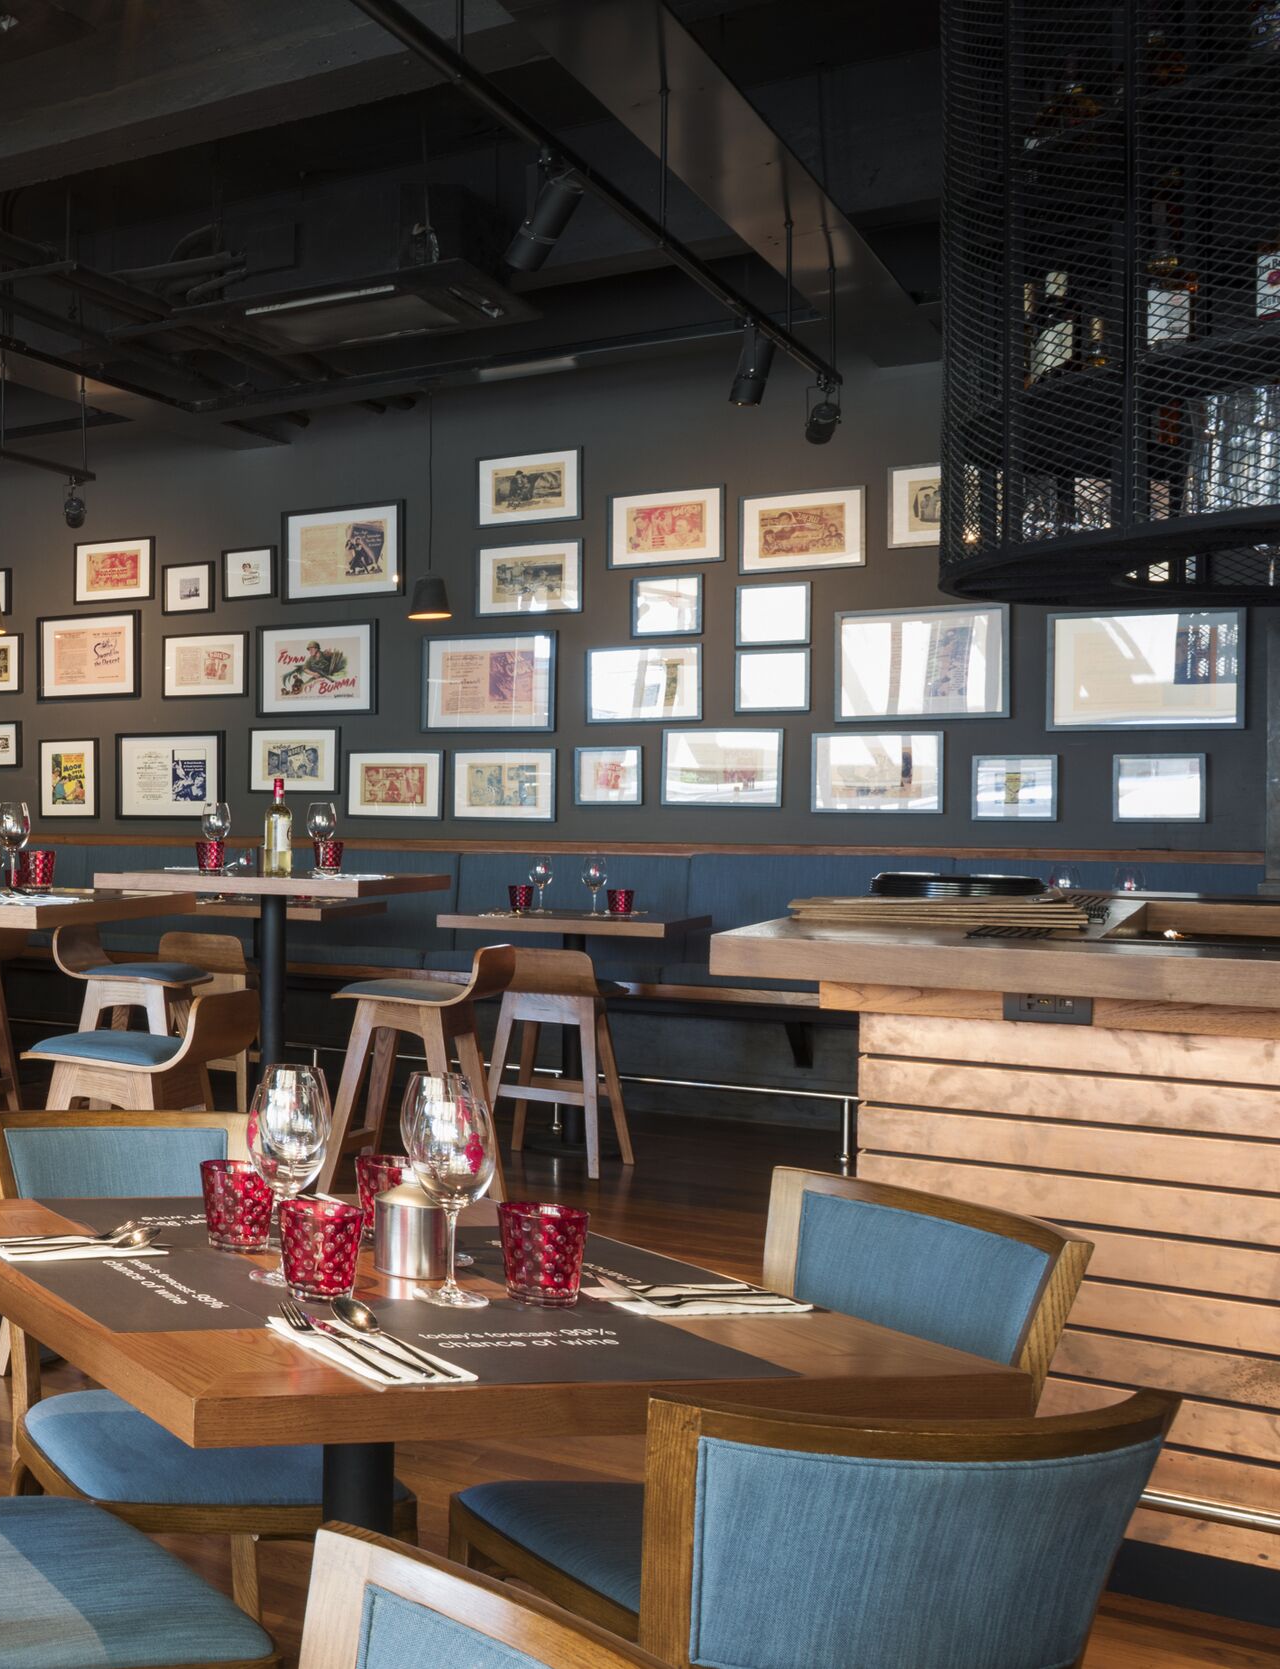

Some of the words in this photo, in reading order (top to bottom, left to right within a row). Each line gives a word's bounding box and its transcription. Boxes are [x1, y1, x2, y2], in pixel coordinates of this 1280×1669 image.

[437, 1338, 528, 1350] chance
[531, 1338, 558, 1347] of
[559, 1337, 621, 1347] wine
